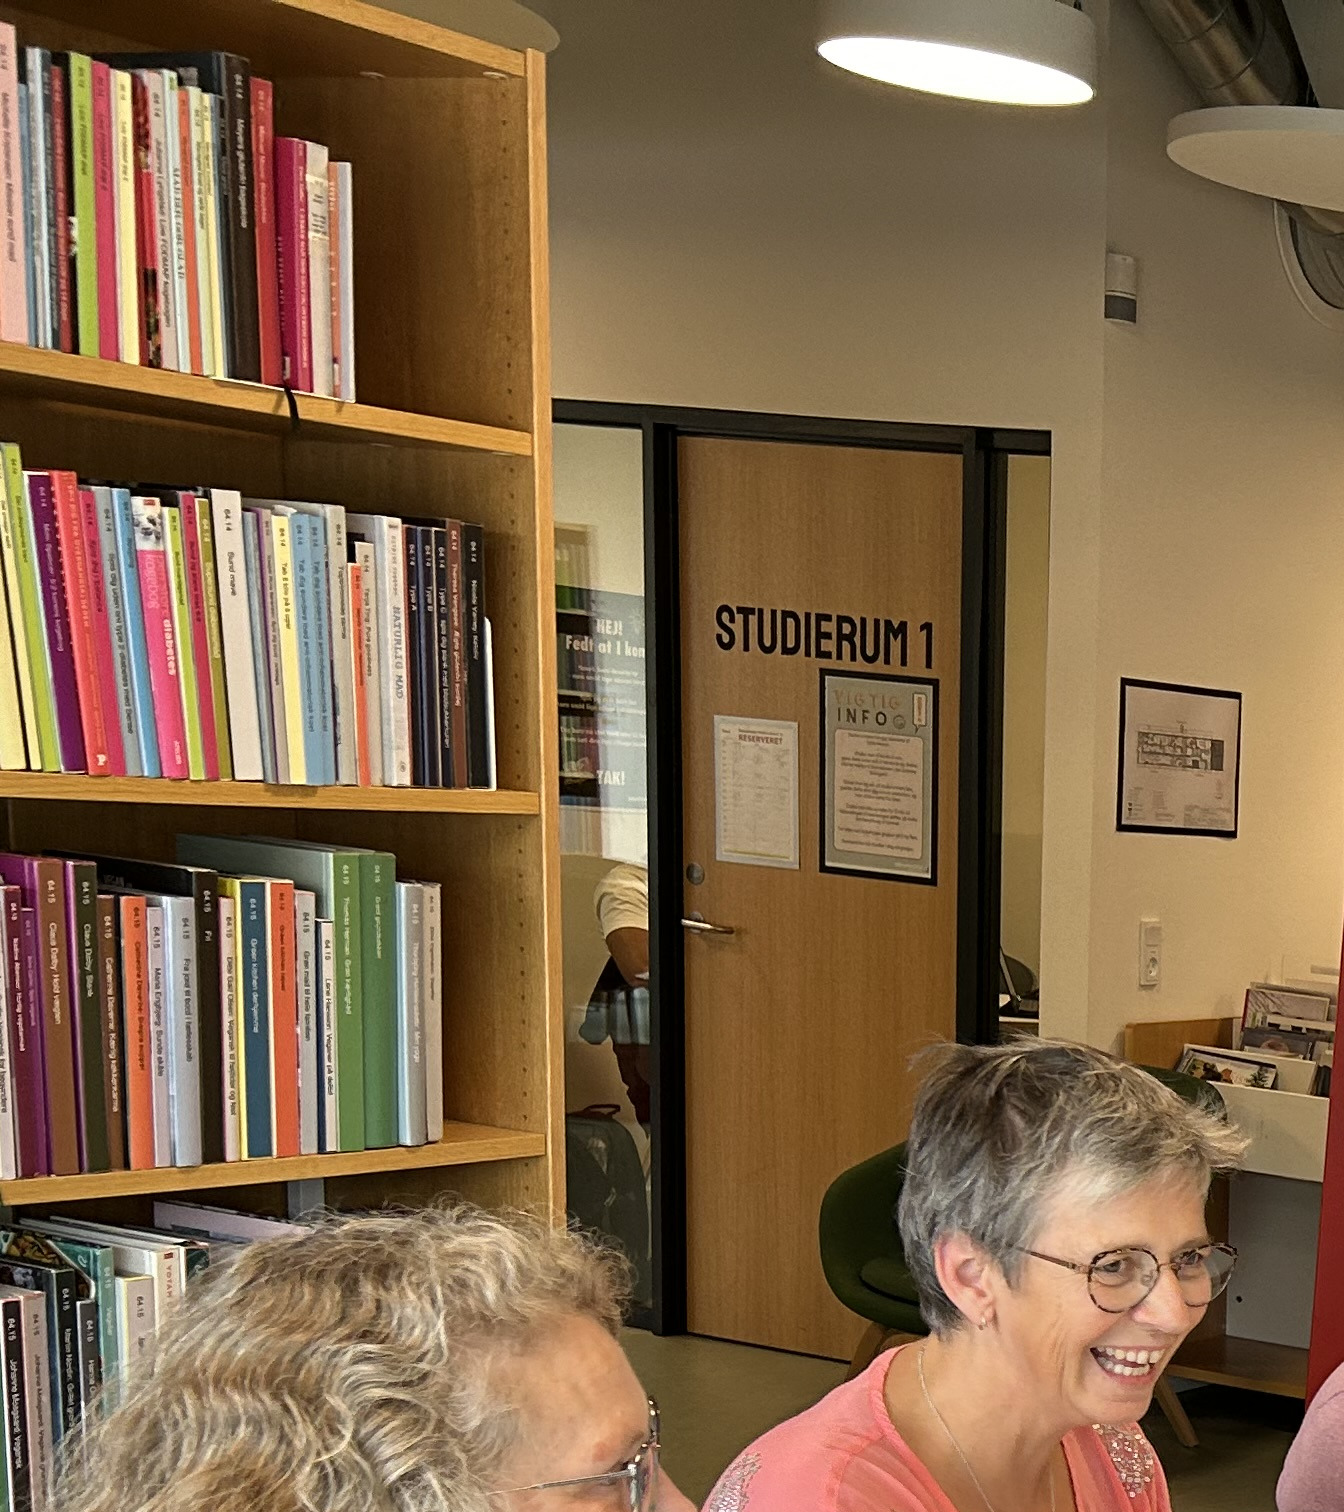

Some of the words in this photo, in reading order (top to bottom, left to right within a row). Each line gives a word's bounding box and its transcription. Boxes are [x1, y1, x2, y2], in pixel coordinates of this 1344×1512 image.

[235, 119, 246, 149] Meyers
[238, 186, 248, 228] bageskole
[159, 219, 167, 236] Low
[160, 238, 169, 279] FODMAP
[162, 281, 172, 328] kogebogen
[202, 519, 210, 542] 64.14
[224, 509, 232, 531] 64.14
[450, 530, 458, 550] 64.14
[227, 551, 236, 573] Sund
[408, 544, 416, 566] 64.14
[438, 547, 446, 568] 64.14
[145, 553, 159, 610] kogebog
[229, 574, 238, 596] mave
[298, 575, 306, 587] dig
[409, 585, 417, 603] Type
[425, 586, 433, 604] Type
[439, 588, 447, 607] Type
[392, 606, 403, 670] NATURLIG
[596, 618, 623, 636] HEJ!
[715, 604, 908, 667] STUDIERUM
[919, 621, 933, 669] 1
[162, 619, 177, 676] diabetes
[565, 634, 594, 652] Fedt
[598, 641, 613, 654] at
[616, 640, 621, 656] I
[123, 688, 133, 707] med
[395, 674, 404, 699] MAD
[832, 688, 900, 710] VIGTIG
[837, 706, 888, 726] INFO
[738, 733, 784, 746] RESERVERET
[596, 769, 625, 786] TAK!
[47, 880, 55, 903] 64.15
[82, 882, 90, 905] 64.15
[203, 890, 212, 913] 64.15
[249, 898, 257, 920] 64.15
[343, 897, 351, 926] Thomas
[49, 922, 58, 946] Claus
[83, 924, 92, 947] Claus
[104, 916, 112, 939] 64.15
[153, 926, 161, 949] 64.15
[182, 917, 190, 940] 64.15
[204, 930, 212, 941] Fri
[49, 948, 59, 971] Dalby:
[250, 938, 259, 961] Green
[303, 951, 311, 970] Grøn
[324, 940, 332, 960] 64.15
[183, 958, 191, 972] Fra
[52, 974, 60, 994] Hold
[154, 968, 162, 990] Maria
[182, 973, 192, 988] jord
[251, 963, 260, 990] kitchen
[325, 978, 333, 996] Lene
[184, 989, 193, 997] til
[51, 995, 62, 1025] vægten
[184, 998, 193, 1016] bord
[227, 1020, 237, 1051] Vegansk
[304, 1013, 312, 1041] familien
[156, 1030, 164, 1051] Sunde
[185, 1021, 194, 1063] fællesskab
[326, 1064, 334, 1075] på
[228, 1090, 237, 1100] og
[229, 1101, 238, 1116] fest
[62, 1288, 70, 1311] 64.15
[136, 1296, 144, 1318] 64.15
[7, 1318, 16, 1341] 64.15
[86, 1320, 94, 1342] 64.15
[9, 1359, 19, 1392] Johanne
[13, 1437, 23, 1468] Vegansk
